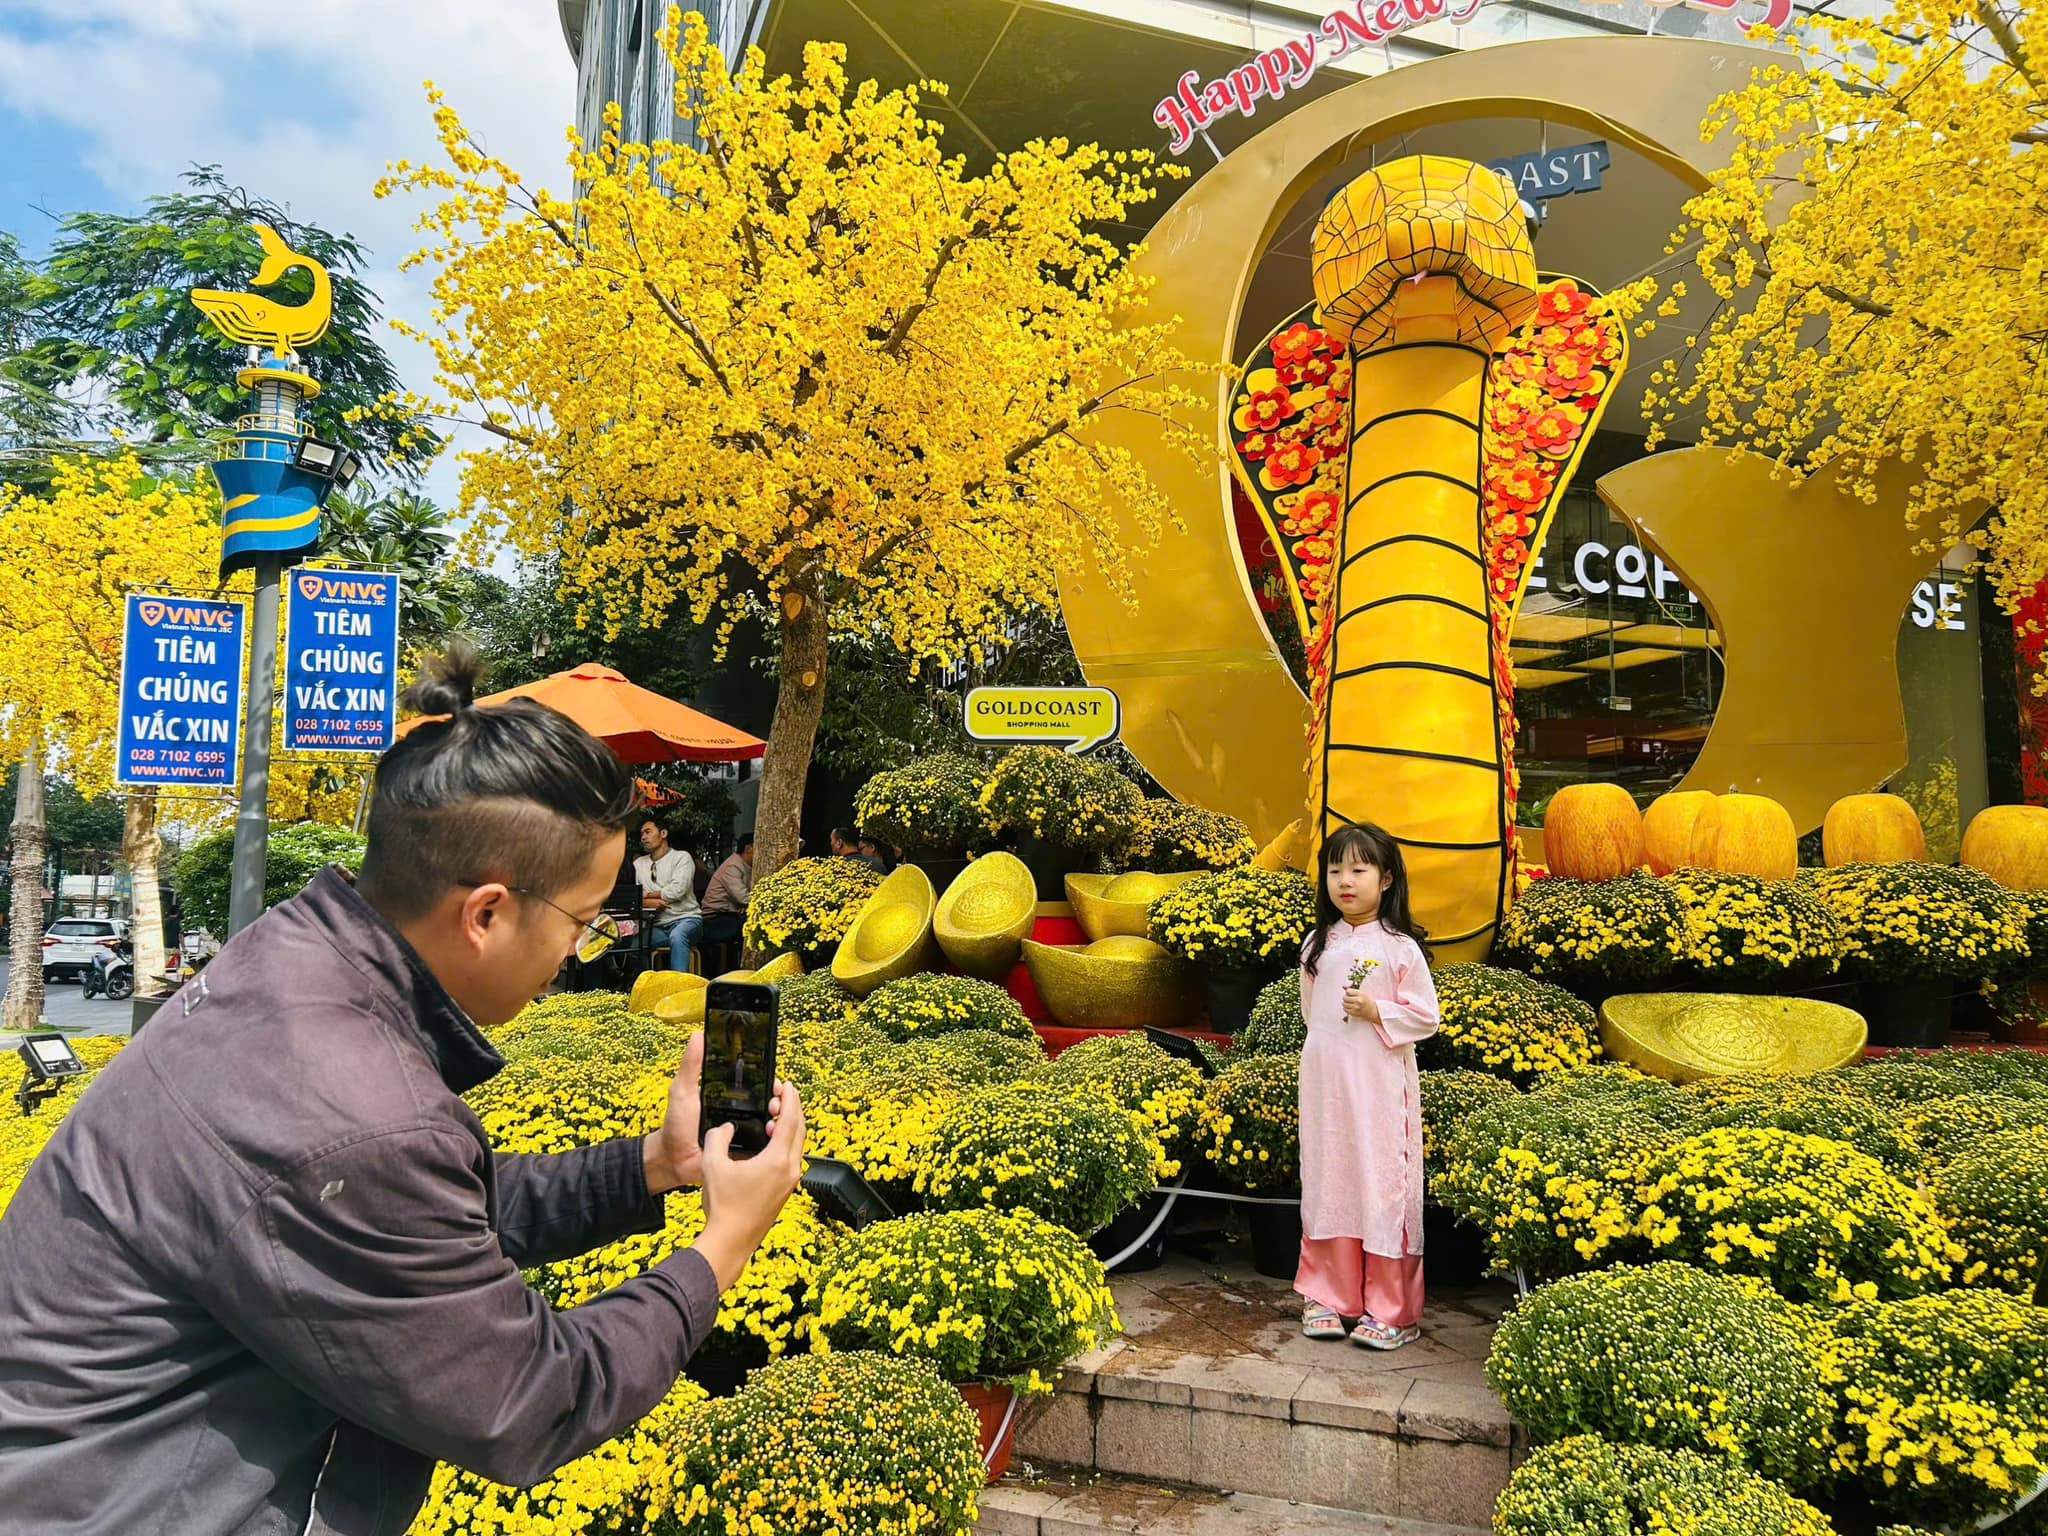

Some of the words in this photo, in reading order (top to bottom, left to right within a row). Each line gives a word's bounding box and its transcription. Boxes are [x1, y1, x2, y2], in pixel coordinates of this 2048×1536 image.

[1154, 31, 1316, 152] Happy
[324, 581, 386, 600] VNVC
[161, 623, 190, 631] Vietnam
[166, 606, 234, 627] VNVC
[313, 608, 371, 636] TIÊM
[154, 635, 216, 664] TIÊM
[300, 643, 384, 674] CHỦNG
[138, 672, 228, 704] CHỦNG
[295, 680, 341, 710] VẮC
[345, 688, 385, 712] XIN
[976, 701, 1102, 716] GOLDCOAST
[131, 709, 181, 741] VẮC
[185, 717, 229, 743] XIN
[295, 718, 318, 730] 028
[322, 719, 350, 731] 7102
[354, 720, 383, 732] 6595
[295, 734, 383, 745] www.vnvc.vn
[130, 748, 155, 761] 028
[160, 750, 190, 762] 7102
[195, 751, 225, 763] 6595
[130, 765, 225, 778] www.vnvc.vn
